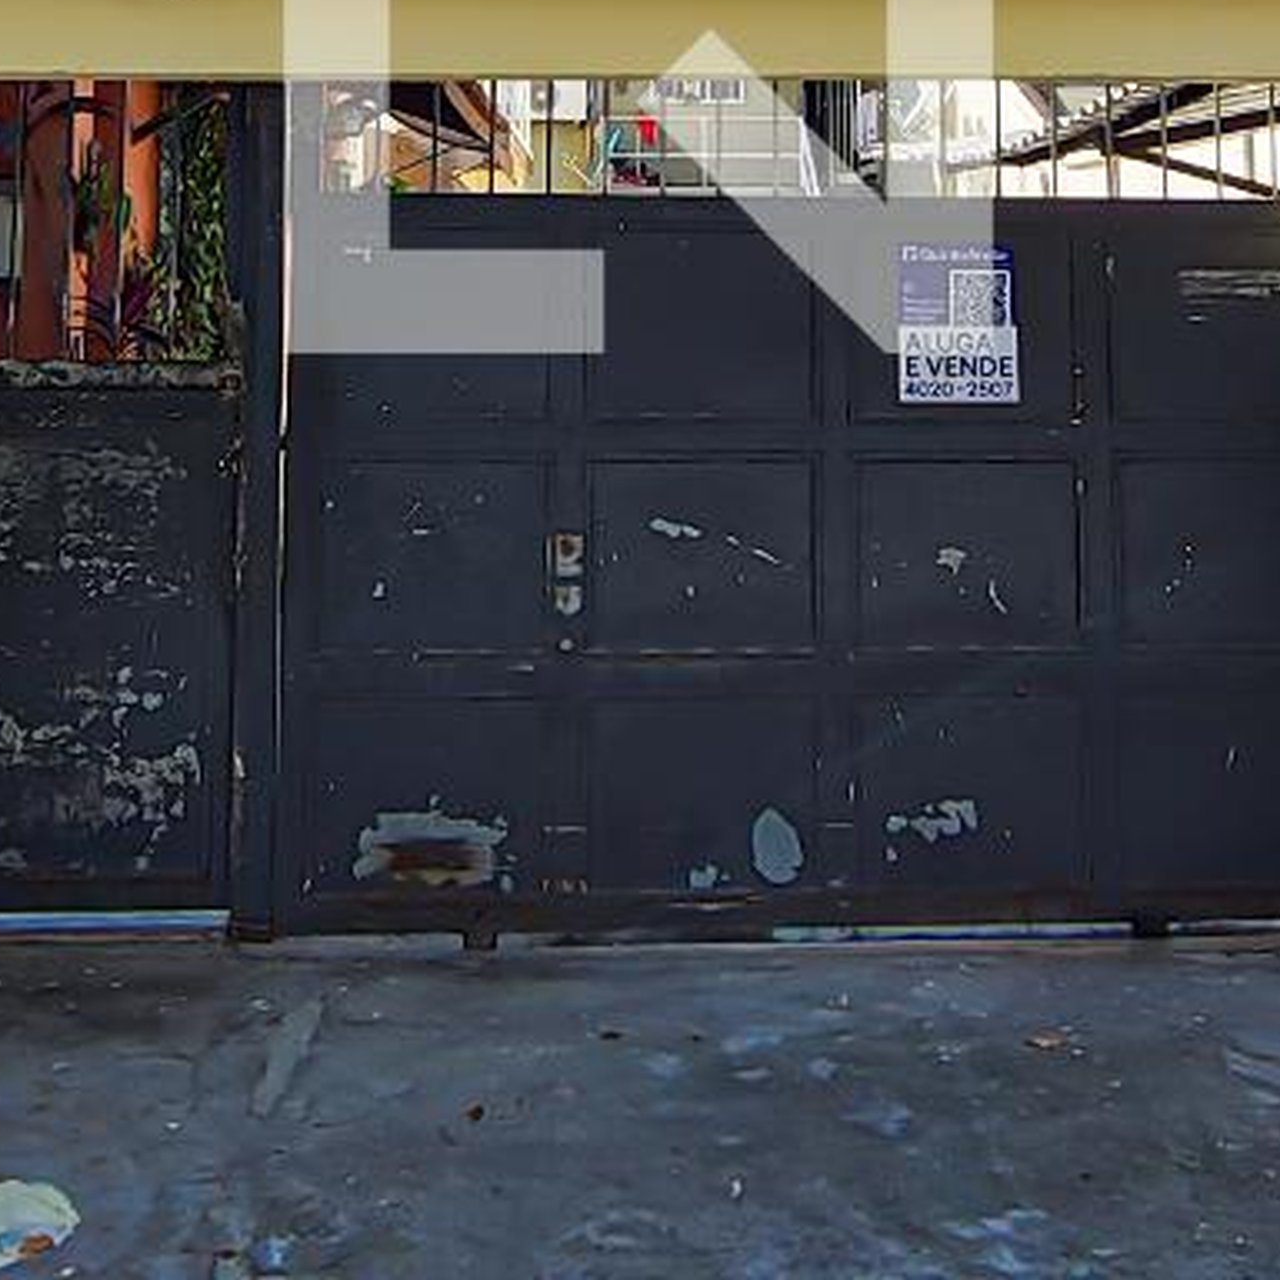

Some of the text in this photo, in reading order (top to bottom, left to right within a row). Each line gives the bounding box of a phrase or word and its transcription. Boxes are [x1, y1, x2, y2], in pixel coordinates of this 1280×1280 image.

[905, 332, 992, 354] ALUGA
[906, 355, 1014, 378] E VENDE
